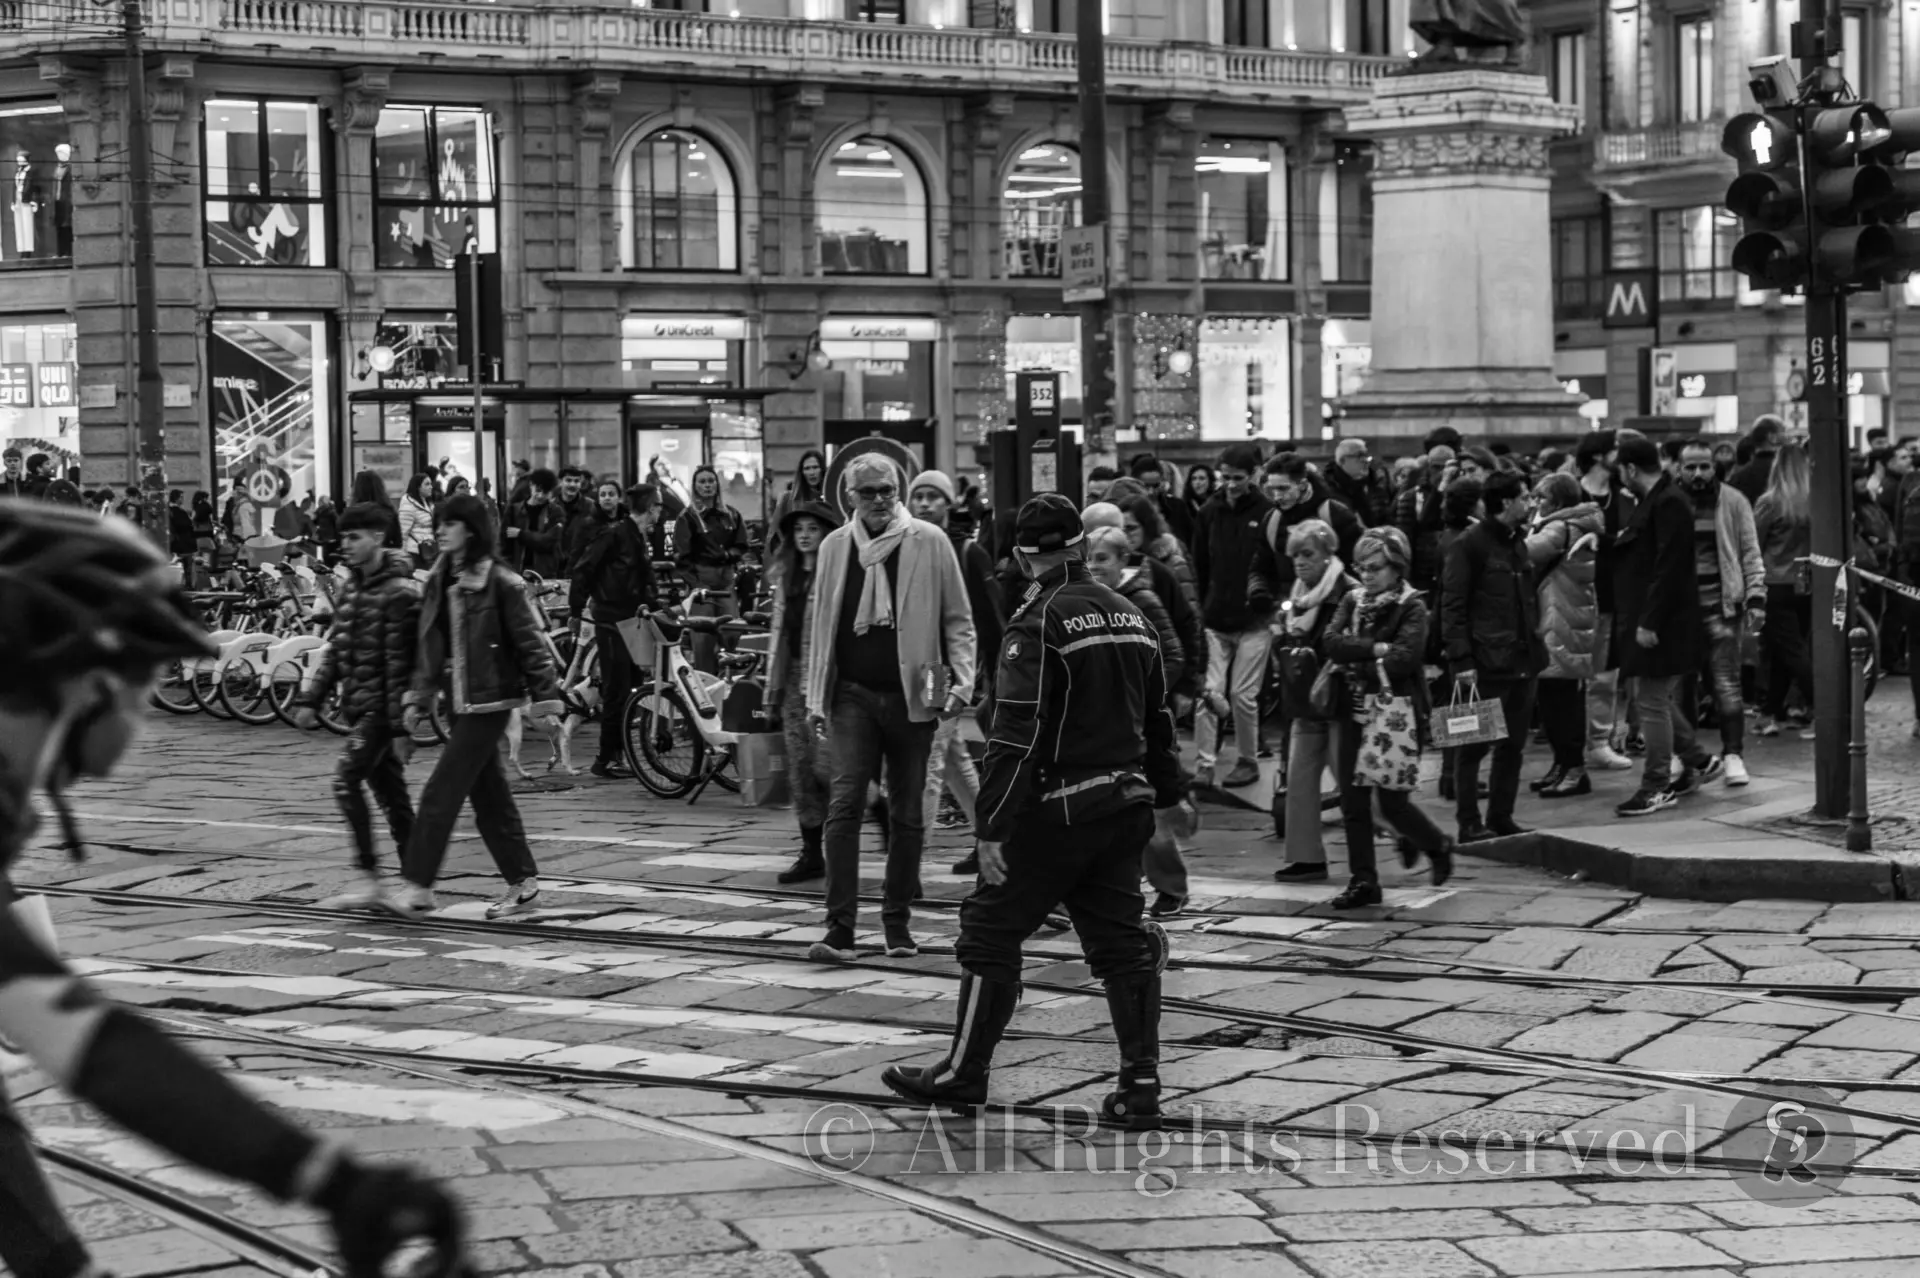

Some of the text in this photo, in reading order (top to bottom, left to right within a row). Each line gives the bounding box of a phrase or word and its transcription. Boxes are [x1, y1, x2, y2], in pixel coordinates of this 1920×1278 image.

[1607, 281, 1648, 317] M
[667, 325, 714, 336] UniCredit
[40, 366, 67, 384] UNI
[41, 385, 70, 405] QLO
[1032, 388, 1053, 401] 352
[1063, 613, 1146, 634] POLIZIA LOCALE
